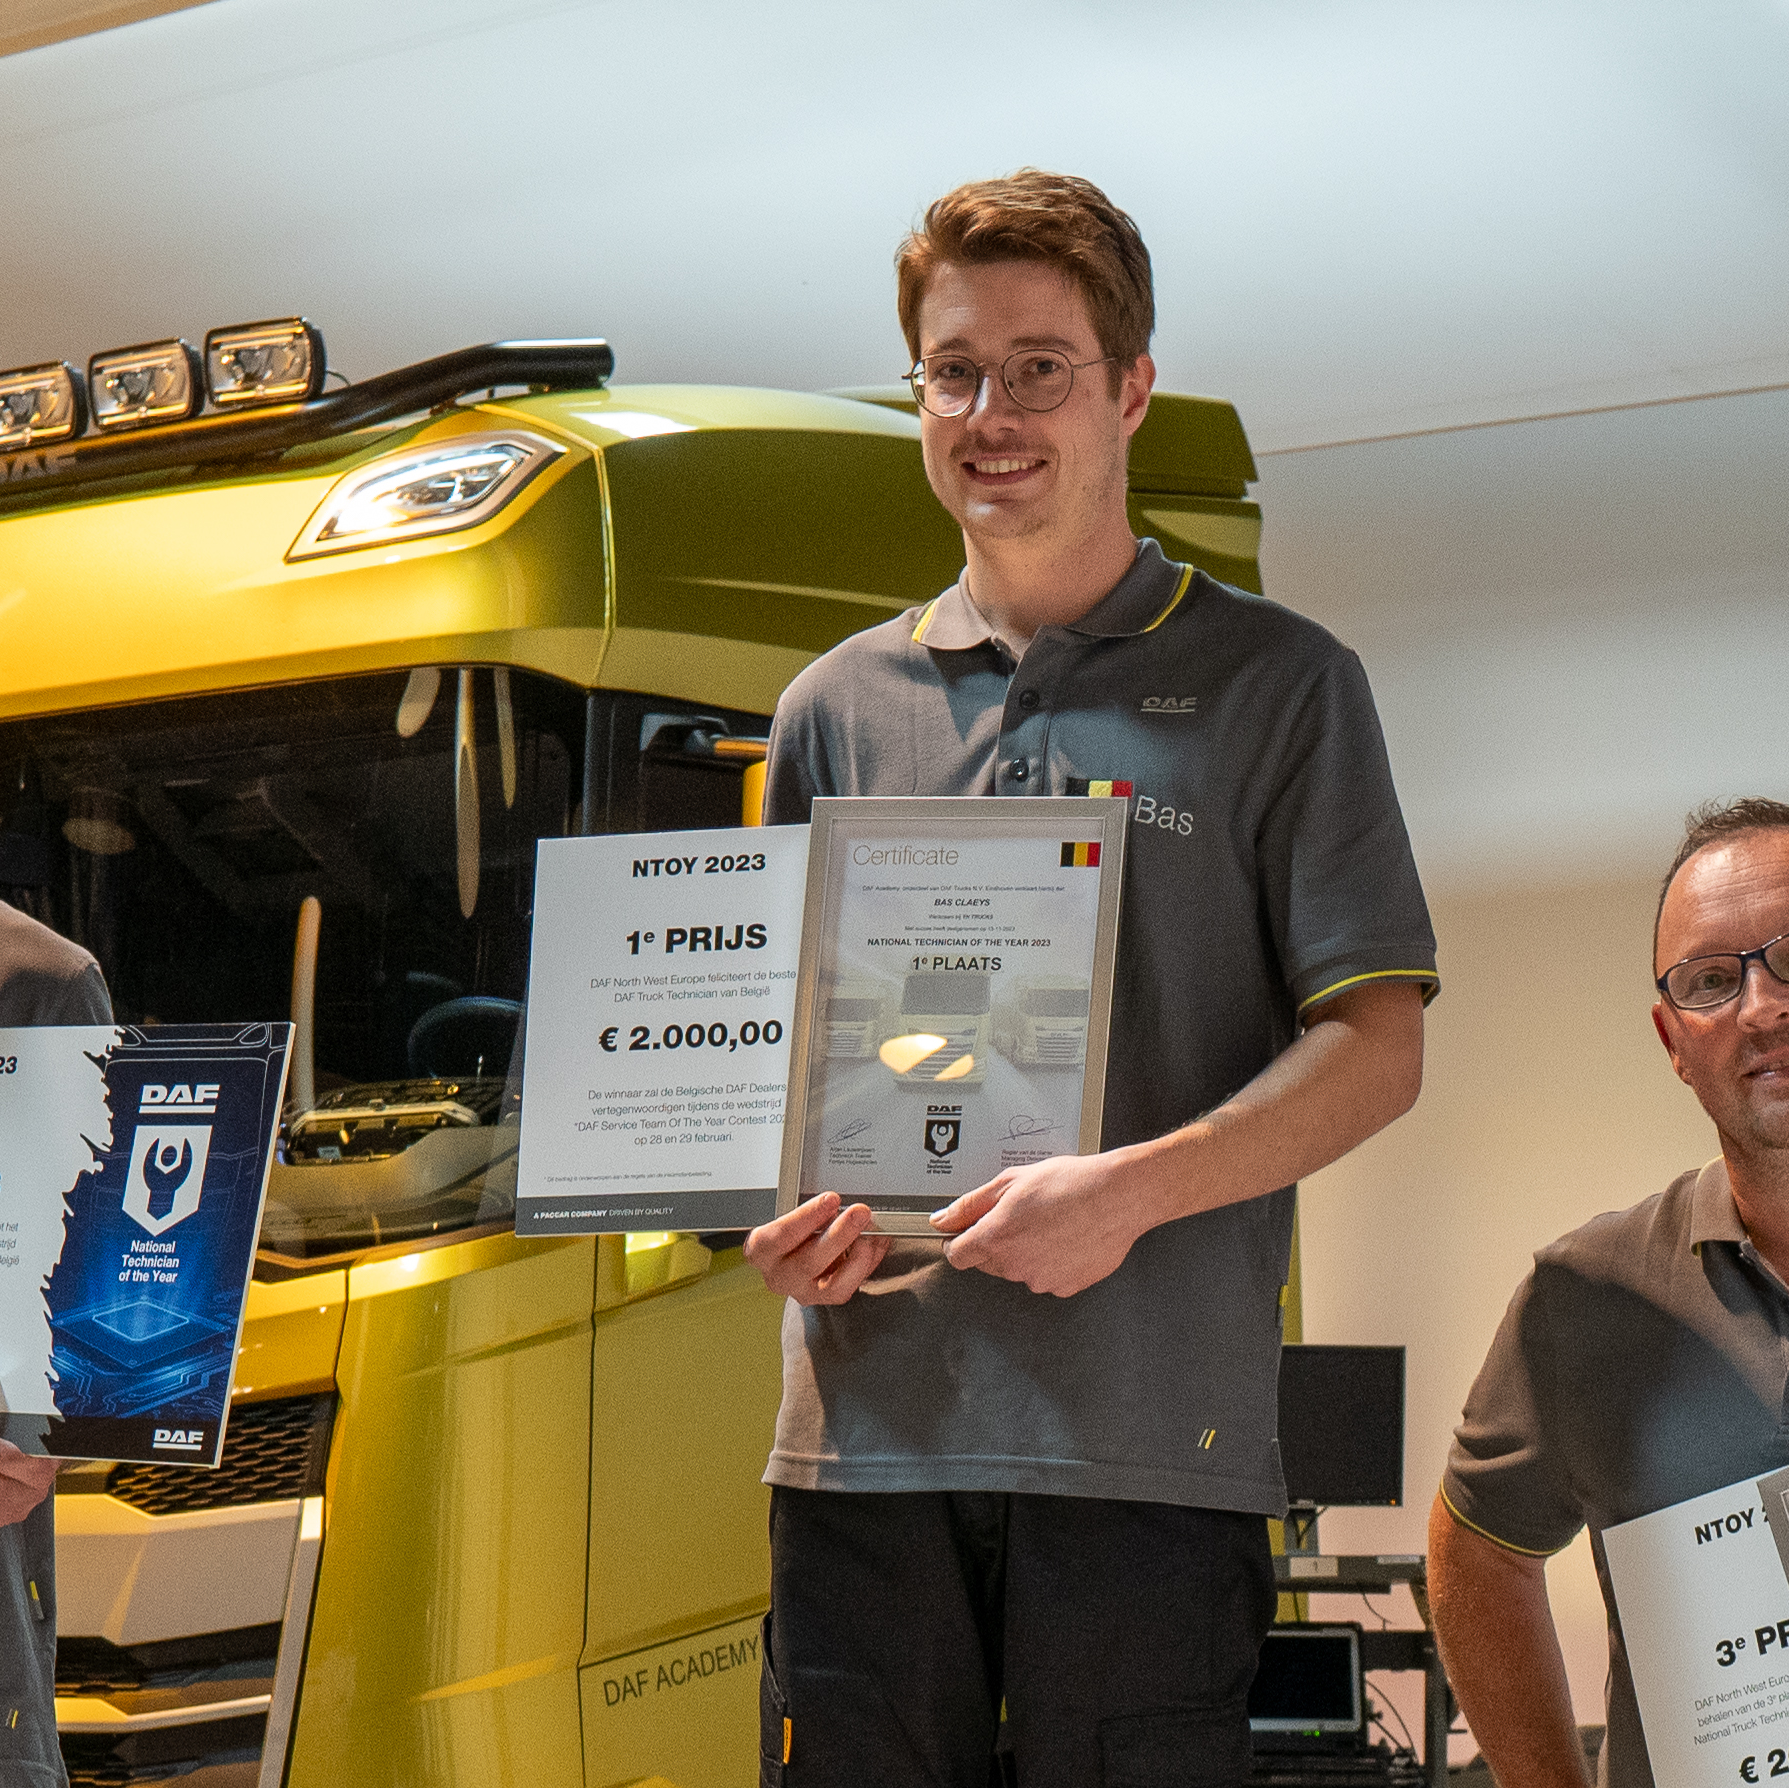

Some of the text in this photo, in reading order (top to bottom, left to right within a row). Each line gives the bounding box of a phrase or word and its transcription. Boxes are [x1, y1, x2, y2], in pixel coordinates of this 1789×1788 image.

[1142, 696, 1198, 709] DAF
[1135, 795, 1194, 835] Bas
[853, 844, 959, 866] Certificate
[632, 853, 767, 877] NTOY 2023
[934, 898, 991, 907] BAS CLAEYS
[626, 923, 768, 955] 1e PRIJS
[867, 938, 1051, 947] NATIONAL TECHNICIAN OF THE YEAR 2023
[912, 956, 1002, 971] 1e PLAATS
[590, 969, 797, 988] DAF North West Europe feliciteert de beste
[614, 985, 770, 1003] DAF Truck Technician van België
[599, 1020, 783, 1052] € 2.000,00
[140, 1084, 220, 1104] DAF
[588, 1082, 787, 1100] De winnaar zal de Belgische DAF Dealers
[592, 1098, 782, 1116] vertegenwoordigen tijdens de wedstrijd
[927, 1105, 962, 1113] DAF
[601, 1114, 767, 1131] Service Team Of The Year Contest
[634, 1132, 734, 1147] op 28 en 29 februari.
[5, 1222, 19, 1232] het
[131, 1240, 176, 1253] National
[121, 1255, 180, 1268] Technician
[118, 1270, 178, 1283] of the Year
[153, 1429, 204, 1443] DAF
[1695, 1507, 1755, 1545] NTOY
[1716, 1637, 1745, 1667] 3e
[603, 1635, 759, 1706] DAF ACADEMY
[1695, 1699, 1714, 1711] DAF
[1716, 1689, 1742, 1706] North
[1744, 1679, 1767, 1698] West
[1697, 1709, 1734, 1728] behalen
[1735, 1703, 1752, 1716] van
[1754, 1697, 1766, 1710] de
[1767, 1694, 1777, 1707] 3e
[1694, 1725, 1731, 1746] National
[1731, 1717, 1758, 1735] Truck
[1739, 1756, 1759, 1784] €
